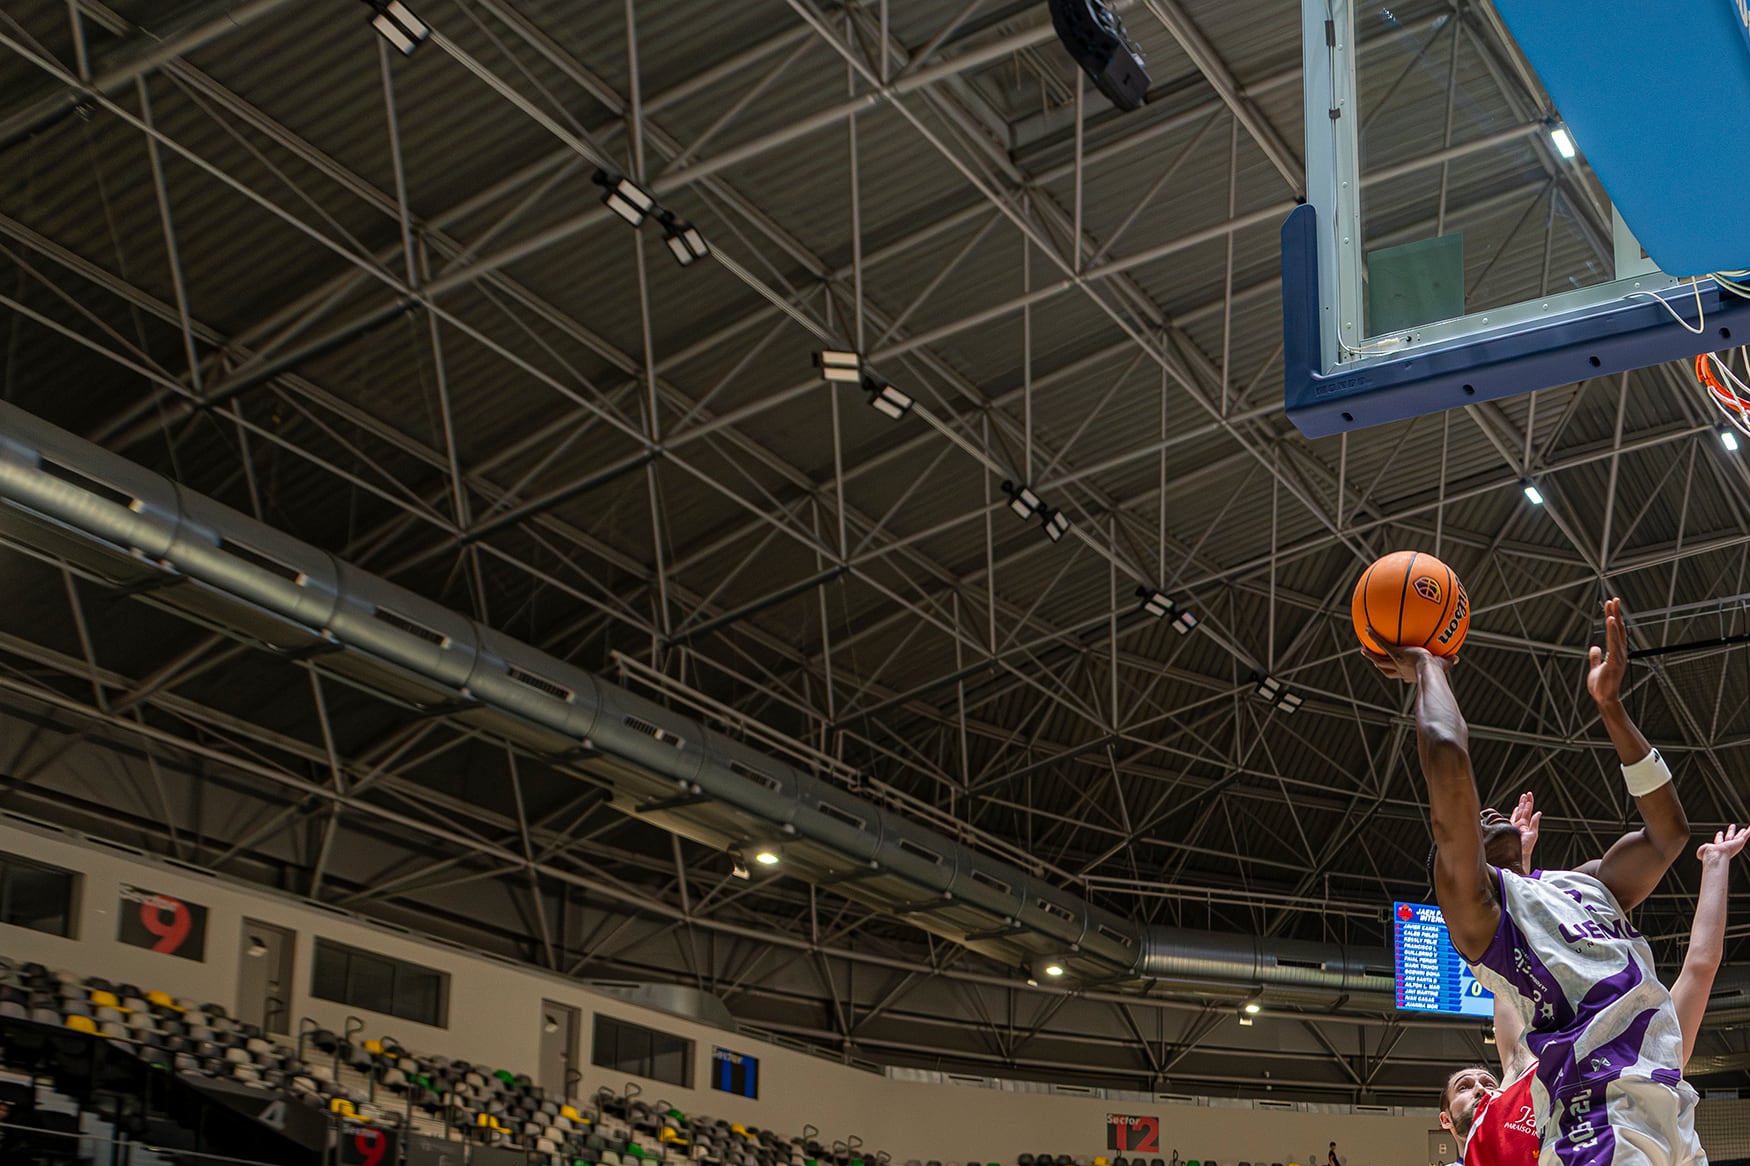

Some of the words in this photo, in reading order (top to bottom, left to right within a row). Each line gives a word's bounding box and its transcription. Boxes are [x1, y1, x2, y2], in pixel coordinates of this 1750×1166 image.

[141, 893, 192, 955] 9
[1107, 1115, 1140, 1125] Sector
[1515, 1105, 1537, 1127] Ja
[1116, 1115, 1159, 1152] 12
